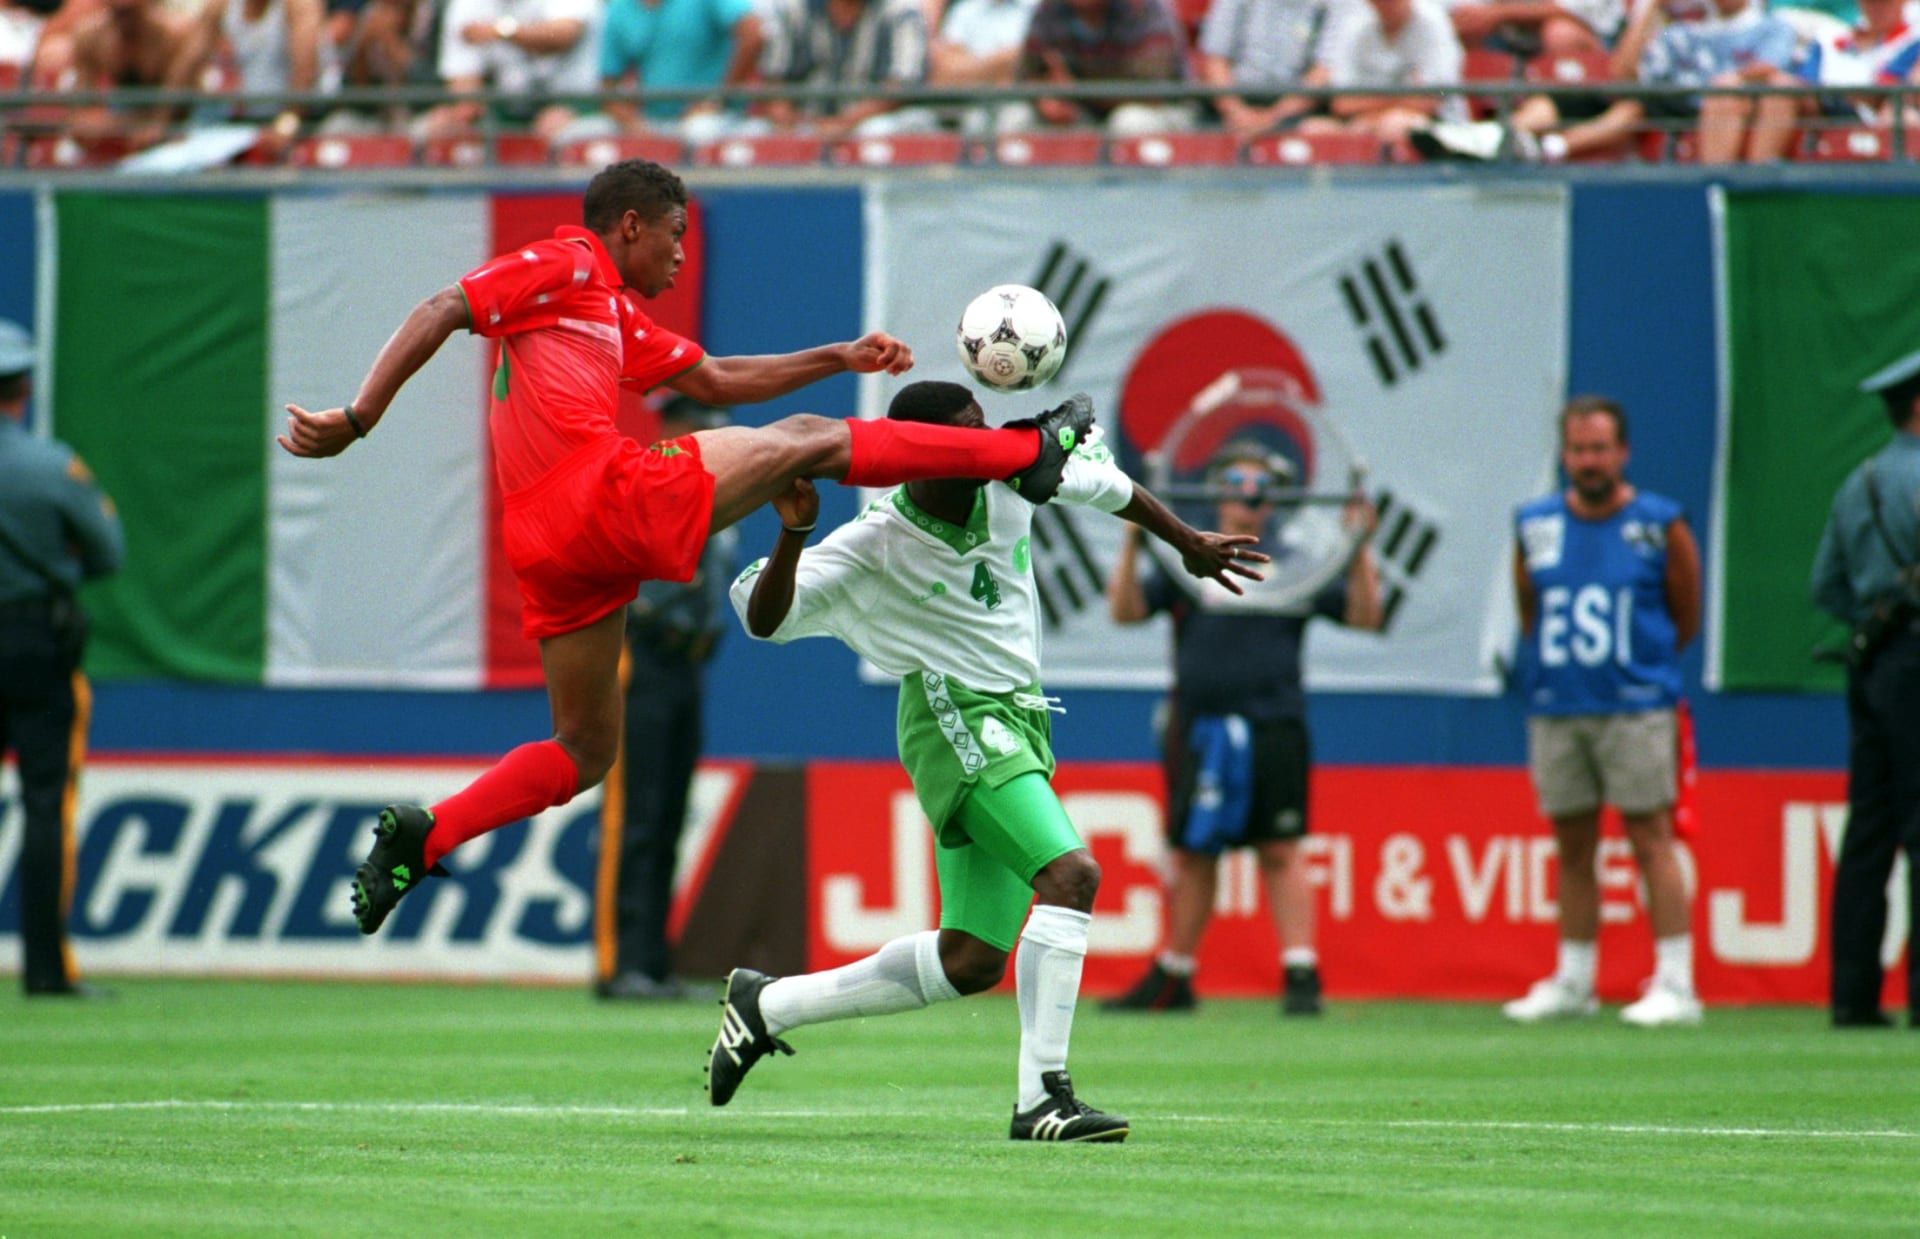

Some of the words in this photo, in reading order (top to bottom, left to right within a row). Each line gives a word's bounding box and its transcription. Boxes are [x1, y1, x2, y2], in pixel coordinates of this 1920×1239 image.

[970, 560, 1001, 611] 4
[980, 715, 1021, 756] 4
[0, 795, 597, 944] CKERS
[823, 788, 1176, 957] JC
[1374, 834, 1431, 922] &
